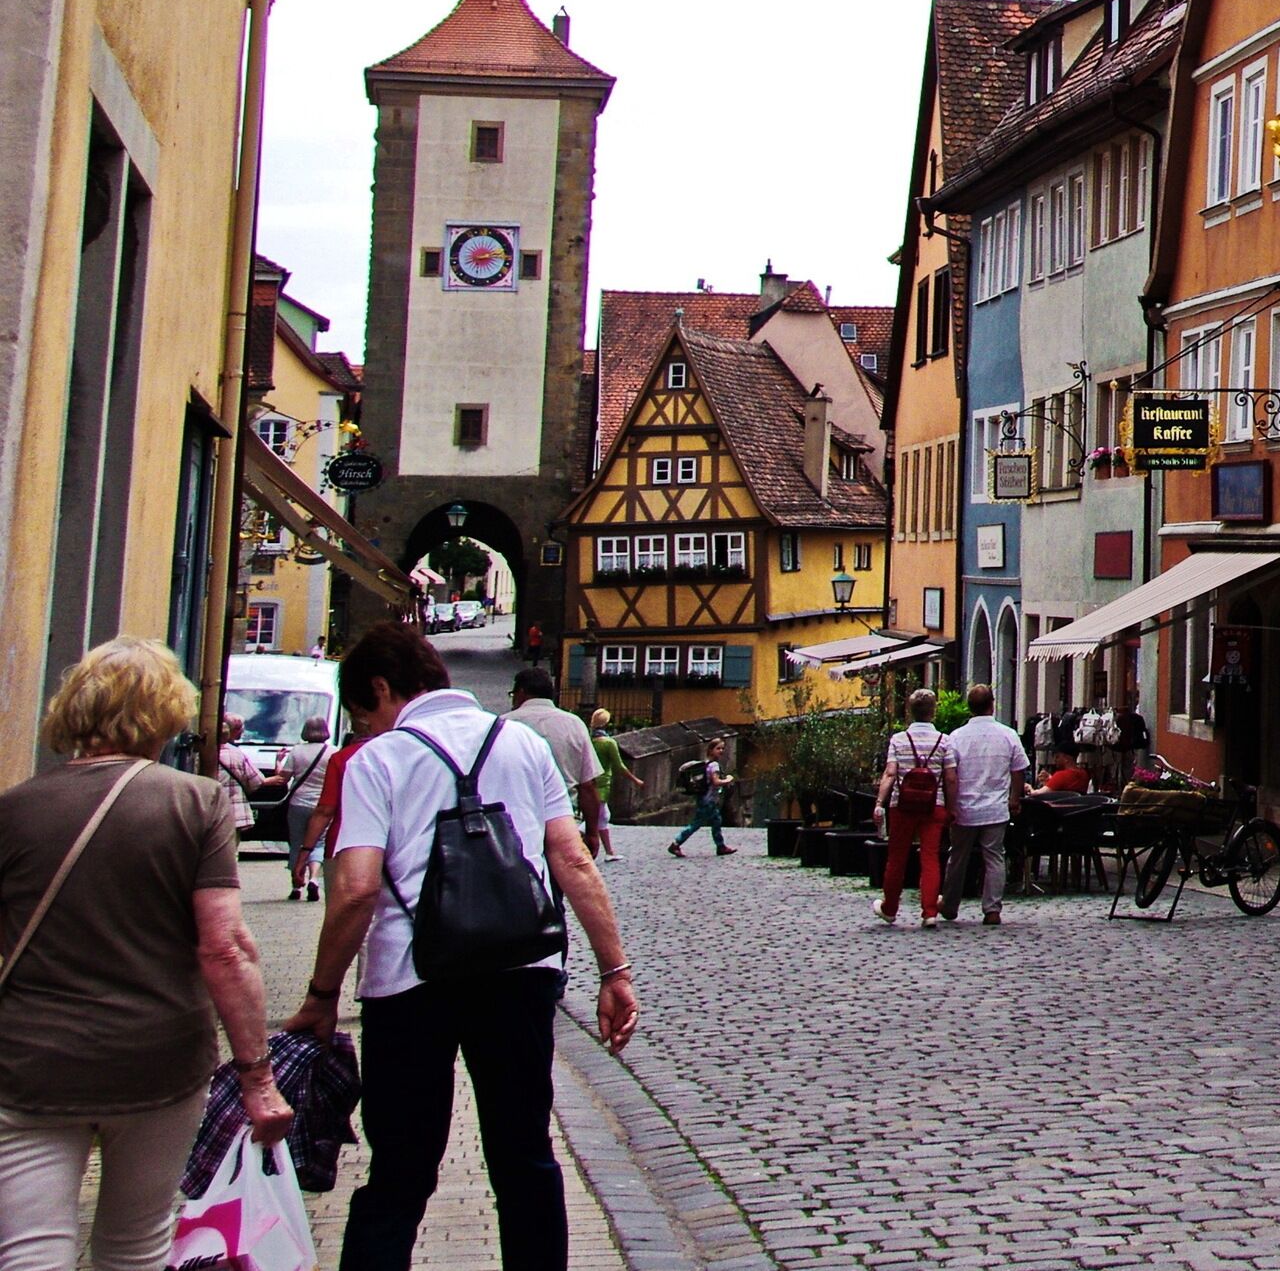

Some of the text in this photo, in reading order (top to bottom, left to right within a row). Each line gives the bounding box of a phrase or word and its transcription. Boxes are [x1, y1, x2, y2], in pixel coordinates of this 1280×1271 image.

[1141, 406, 1203, 422] Restaurant
[1153, 425, 1193, 441] Kaffee
[337, 467, 372, 478] Hirsch
